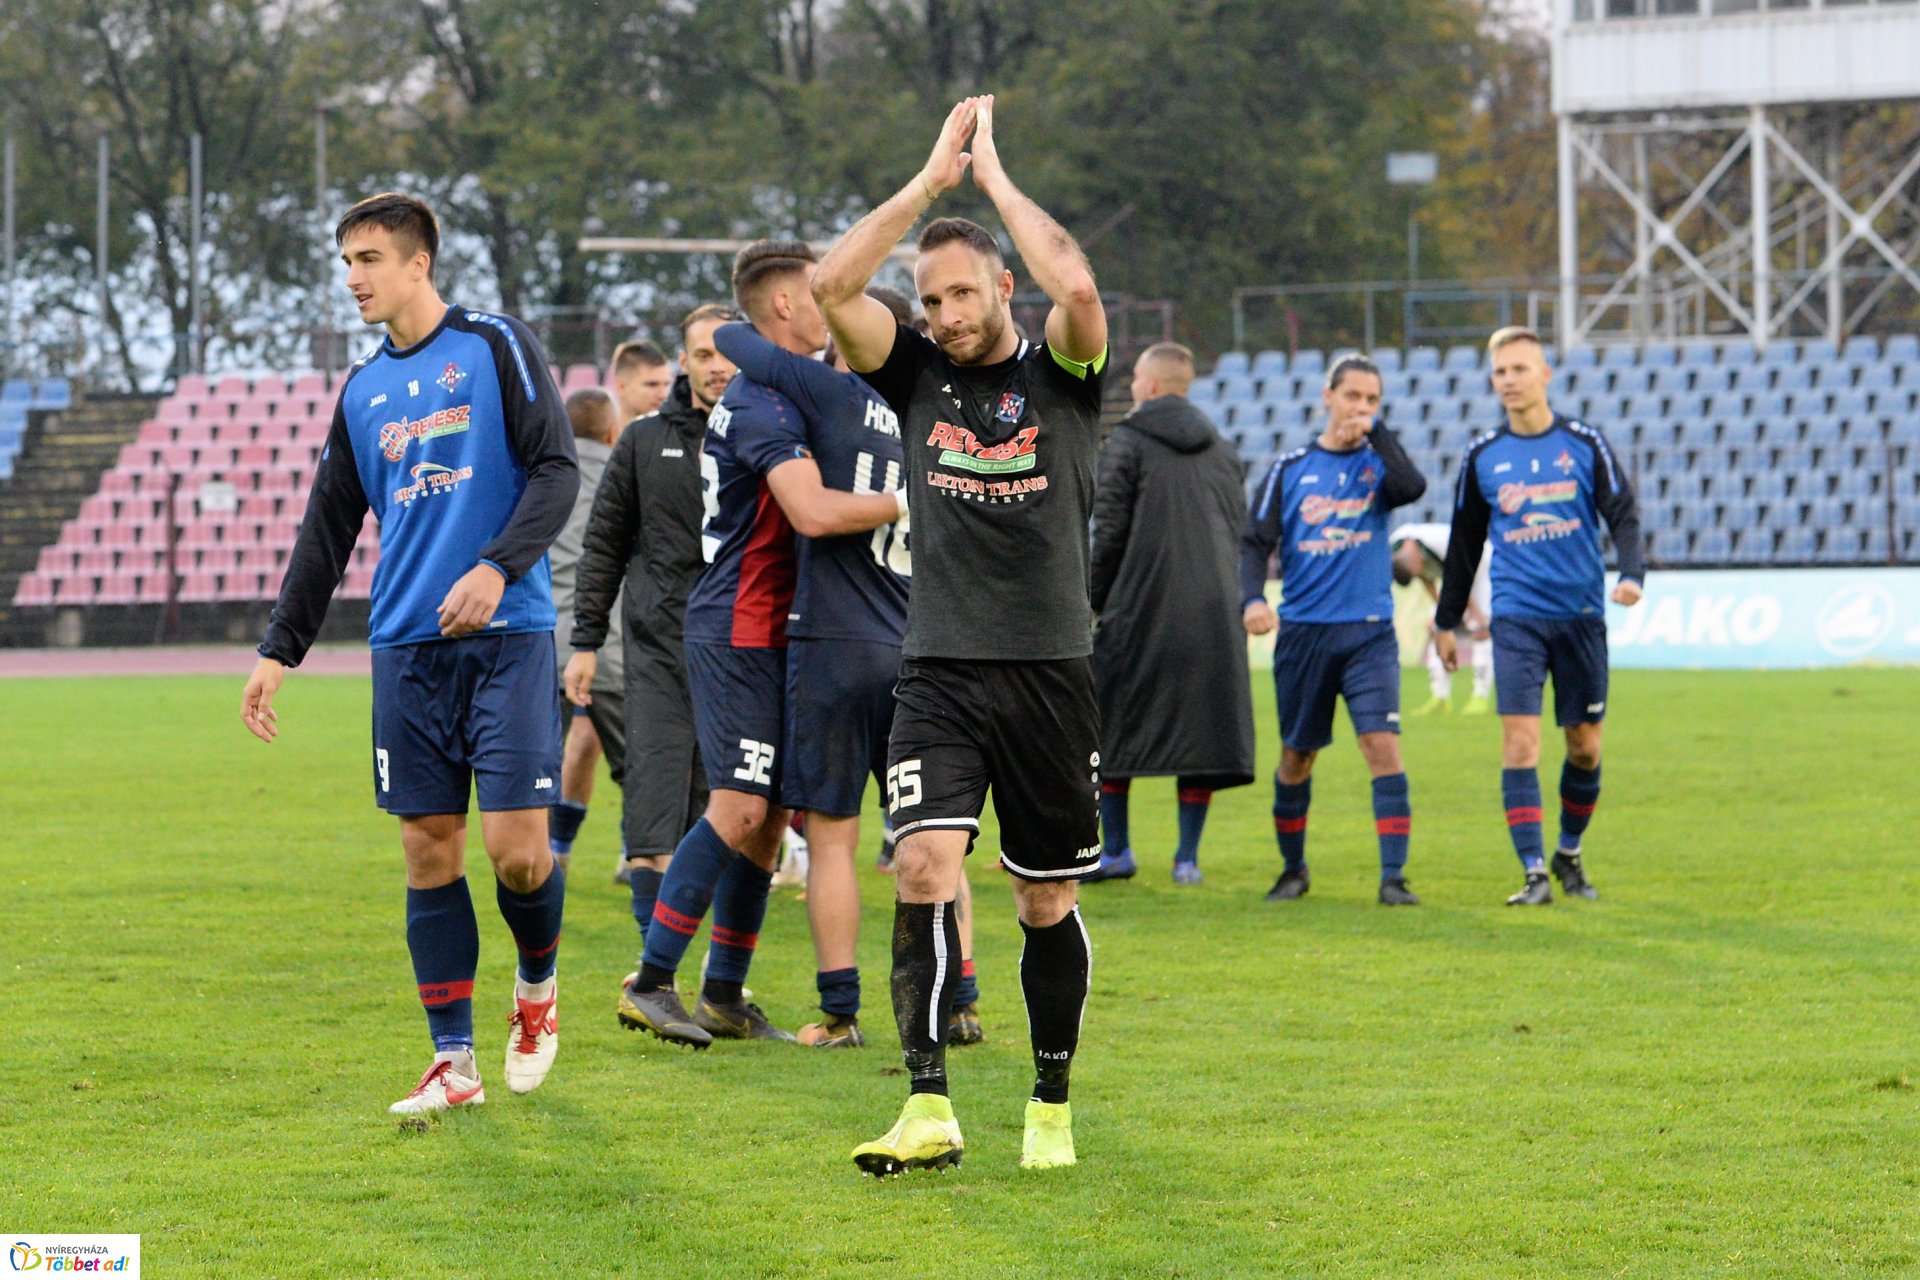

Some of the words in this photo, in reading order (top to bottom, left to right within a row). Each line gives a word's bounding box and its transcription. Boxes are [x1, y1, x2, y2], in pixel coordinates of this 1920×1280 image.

[978, 462, 992, 470] THE
[992, 461, 1017, 470] RIGHT
[986, 476, 1049, 496] TRANS
[1611, 593, 1782, 646] JAKO
[733, 738, 775, 786] 32
[887, 759, 922, 816] 55
[1076, 844, 1101, 859] JAKO
